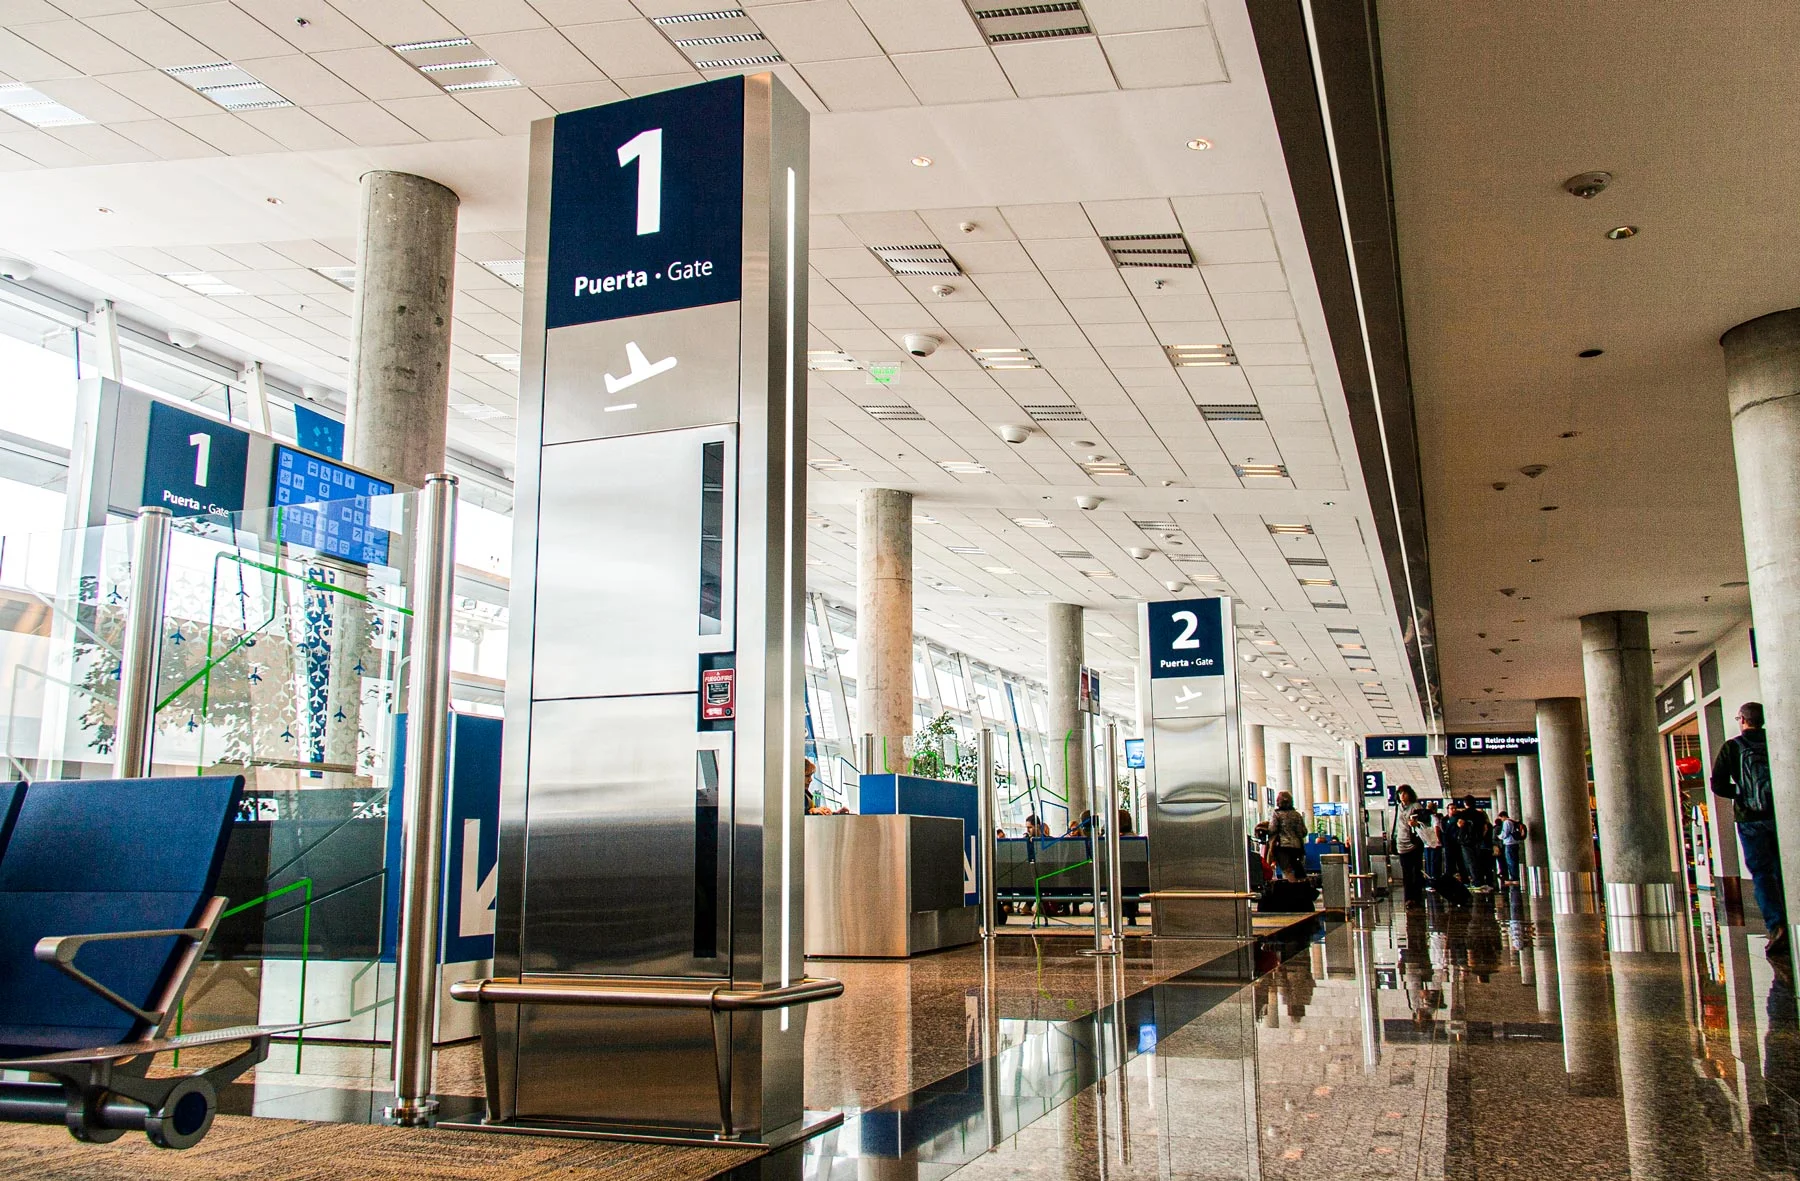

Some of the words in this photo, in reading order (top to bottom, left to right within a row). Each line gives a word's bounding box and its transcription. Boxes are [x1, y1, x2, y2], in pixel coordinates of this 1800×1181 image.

[617, 128, 663, 235] 1
[574, 269, 648, 297] Puerta
[667, 260, 713, 281] Gate
[188, 432, 212, 487] 1
[163, 489, 200, 510] Puerta
[208, 503, 229, 518] Gate
[1171, 610, 1200, 650] 2
[1160, 659, 1189, 668] Puerta
[1195, 657, 1214, 666] Gate
[1485, 736, 1505, 744] Retiro
[1506, 736, 1515, 744] de
[1366, 774, 1377, 789] 3
